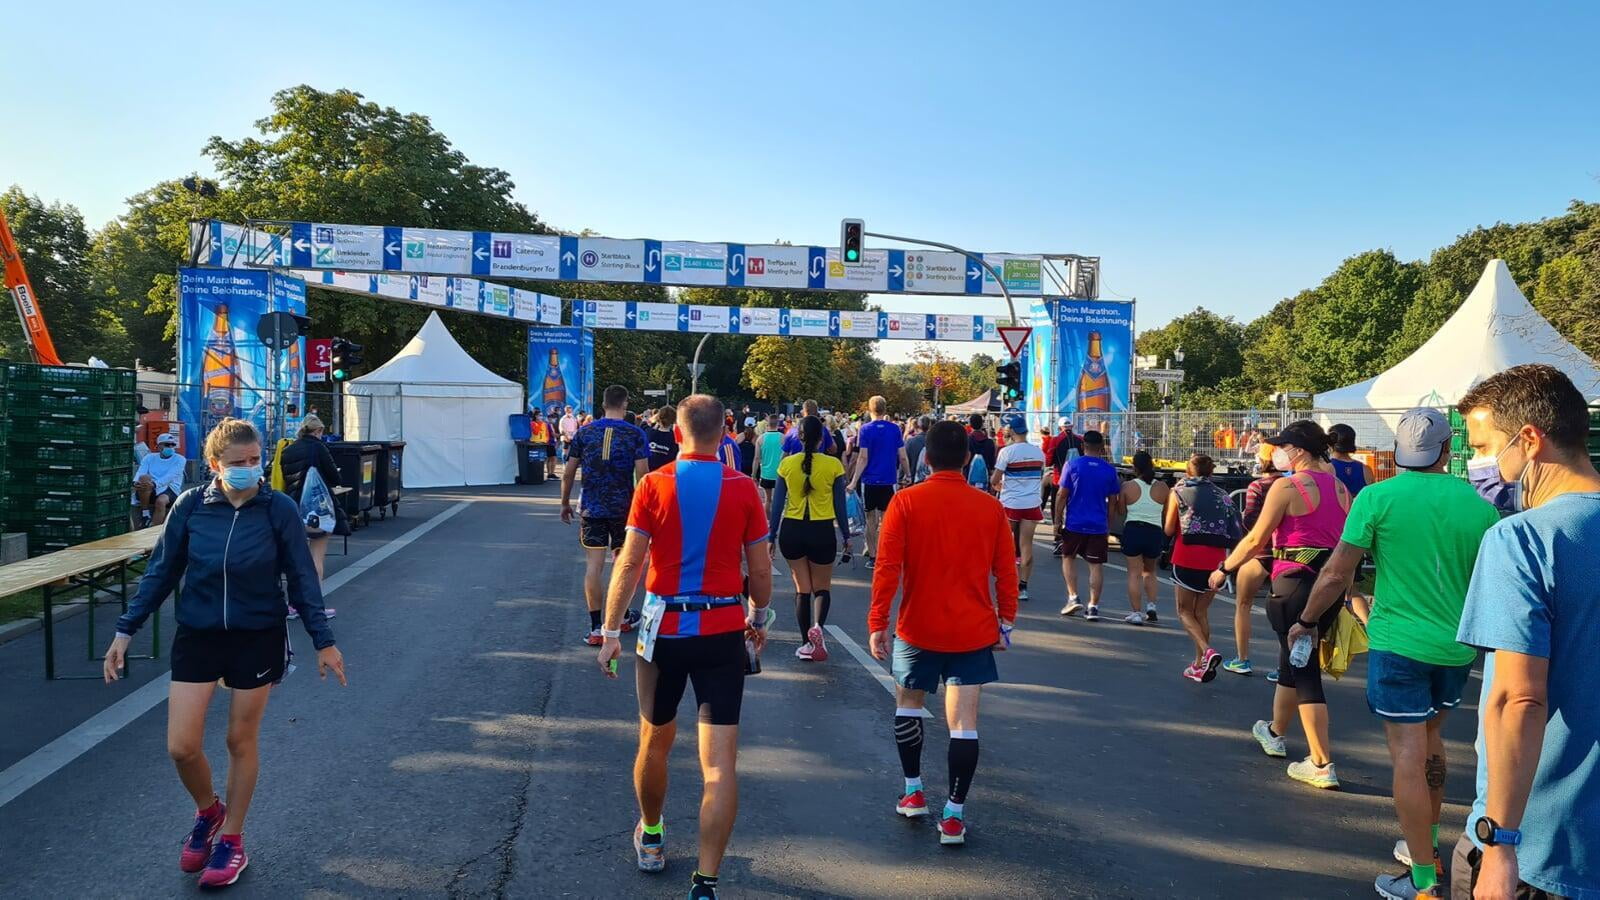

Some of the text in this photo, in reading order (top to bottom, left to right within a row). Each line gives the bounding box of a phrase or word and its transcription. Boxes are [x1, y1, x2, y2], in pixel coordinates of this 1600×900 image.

[515, 247, 545, 257] Catering
[492, 262, 556, 273] Brandenburger Tor
[601, 262, 624, 271] Starting
[767, 259, 798, 267] Treffpunkt
[767, 268, 789, 276] Meeting
[182, 274, 255, 286] Dein Marathon.
[182, 285, 266, 297] Deine Belohnung.
[17, 285, 33, 315] Boels
[1060, 305, 1121, 316] Dein Marathon.
[1060, 315, 1083, 323] Deine
[1085, 316, 1130, 327] Belohnung.
